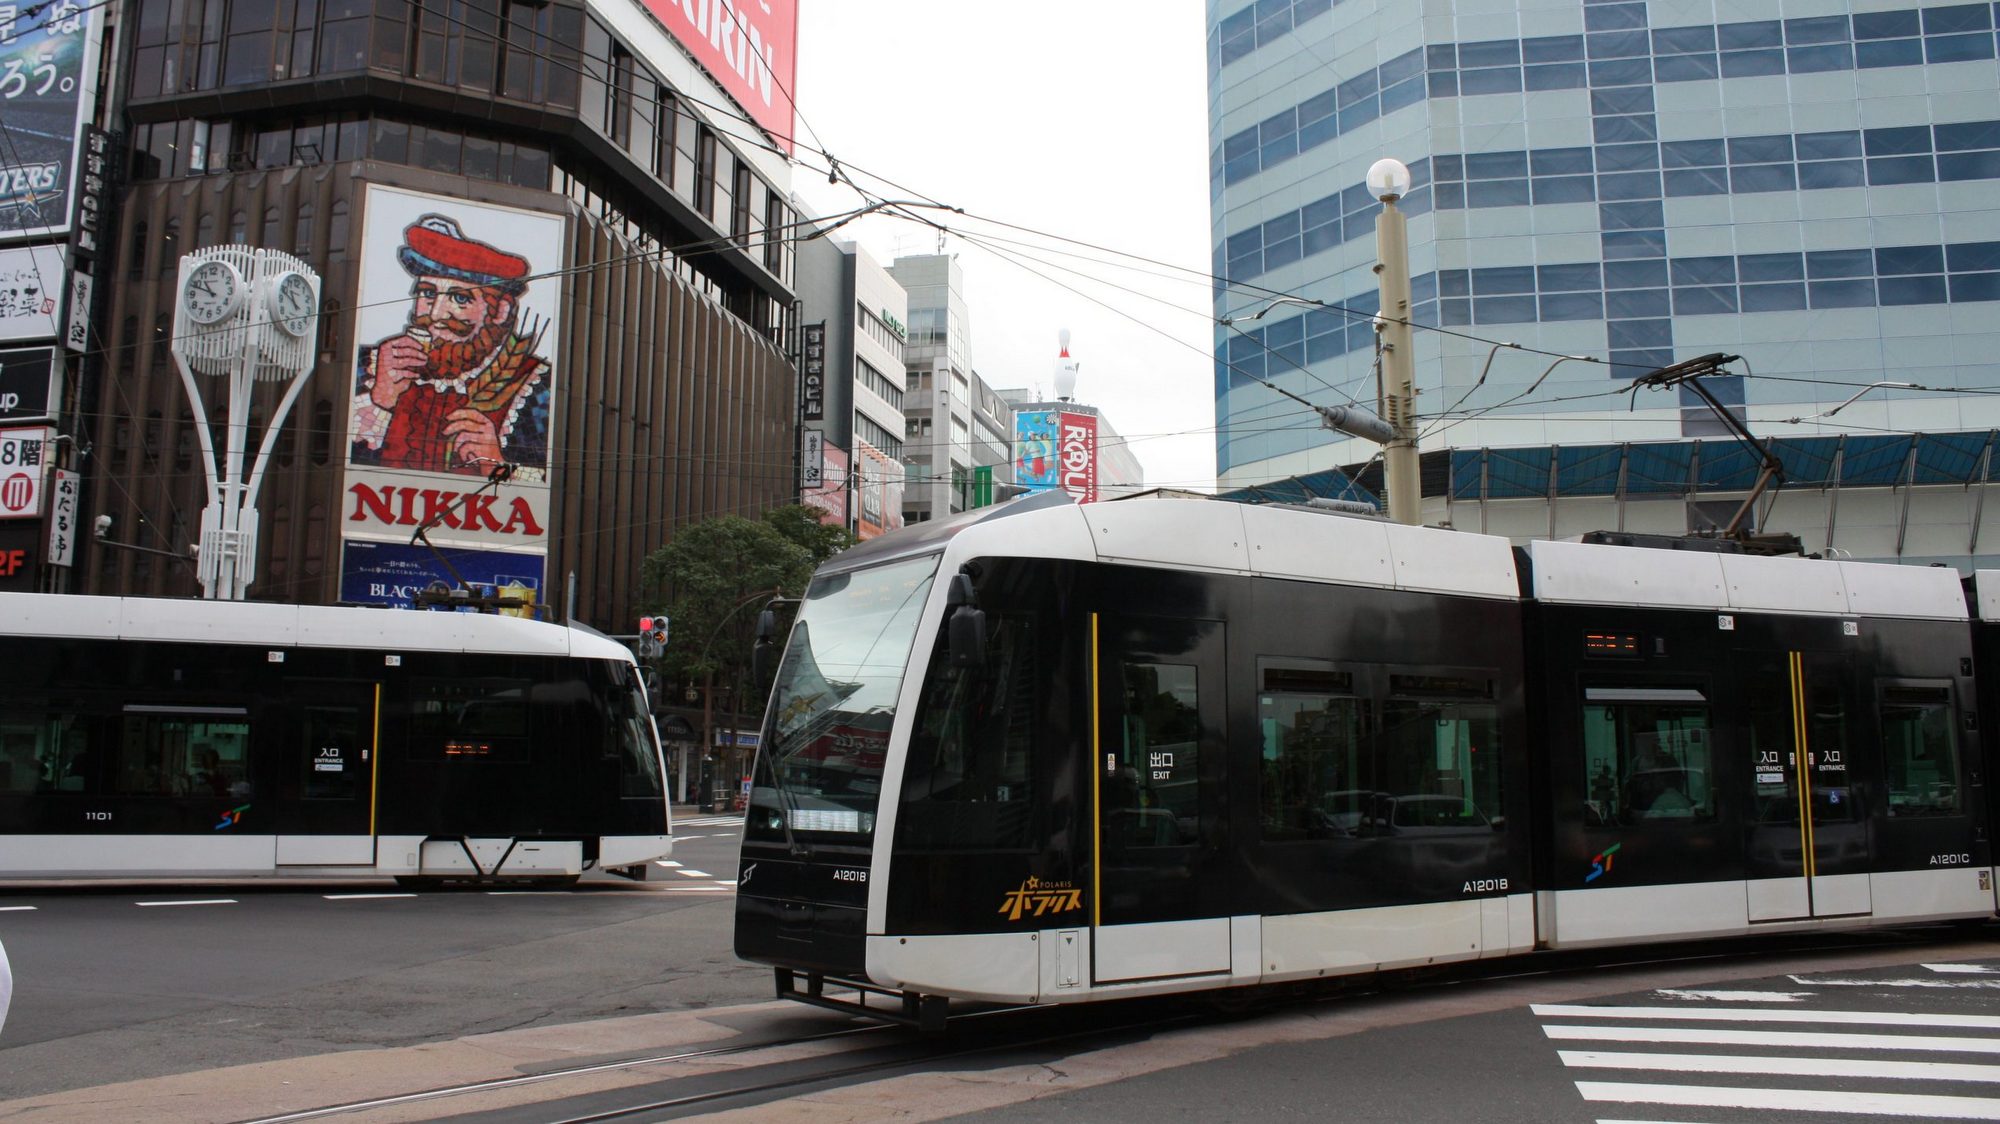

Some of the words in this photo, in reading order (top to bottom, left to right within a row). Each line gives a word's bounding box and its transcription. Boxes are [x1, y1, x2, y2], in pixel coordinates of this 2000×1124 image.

[1, 440, 42, 467] 8階
[348, 482, 545, 537] NIKKA
[320, 747, 339, 757] 入口
[1760, 750, 1779, 763] 入口
[1823, 750, 1841, 762] 入口
[1149, 752, 1174, 768] 出口
[1152, 770, 1171, 781] EXIT
[85, 812, 113, 821] 1101
[1929, 853, 1971, 865] A1201C
[833, 869, 868, 882] A1201B
[1039, 880, 1073, 889] POLARIS
[1462, 878, 1509, 894] A1201B
[997, 876, 1082, 921] ポラリス
